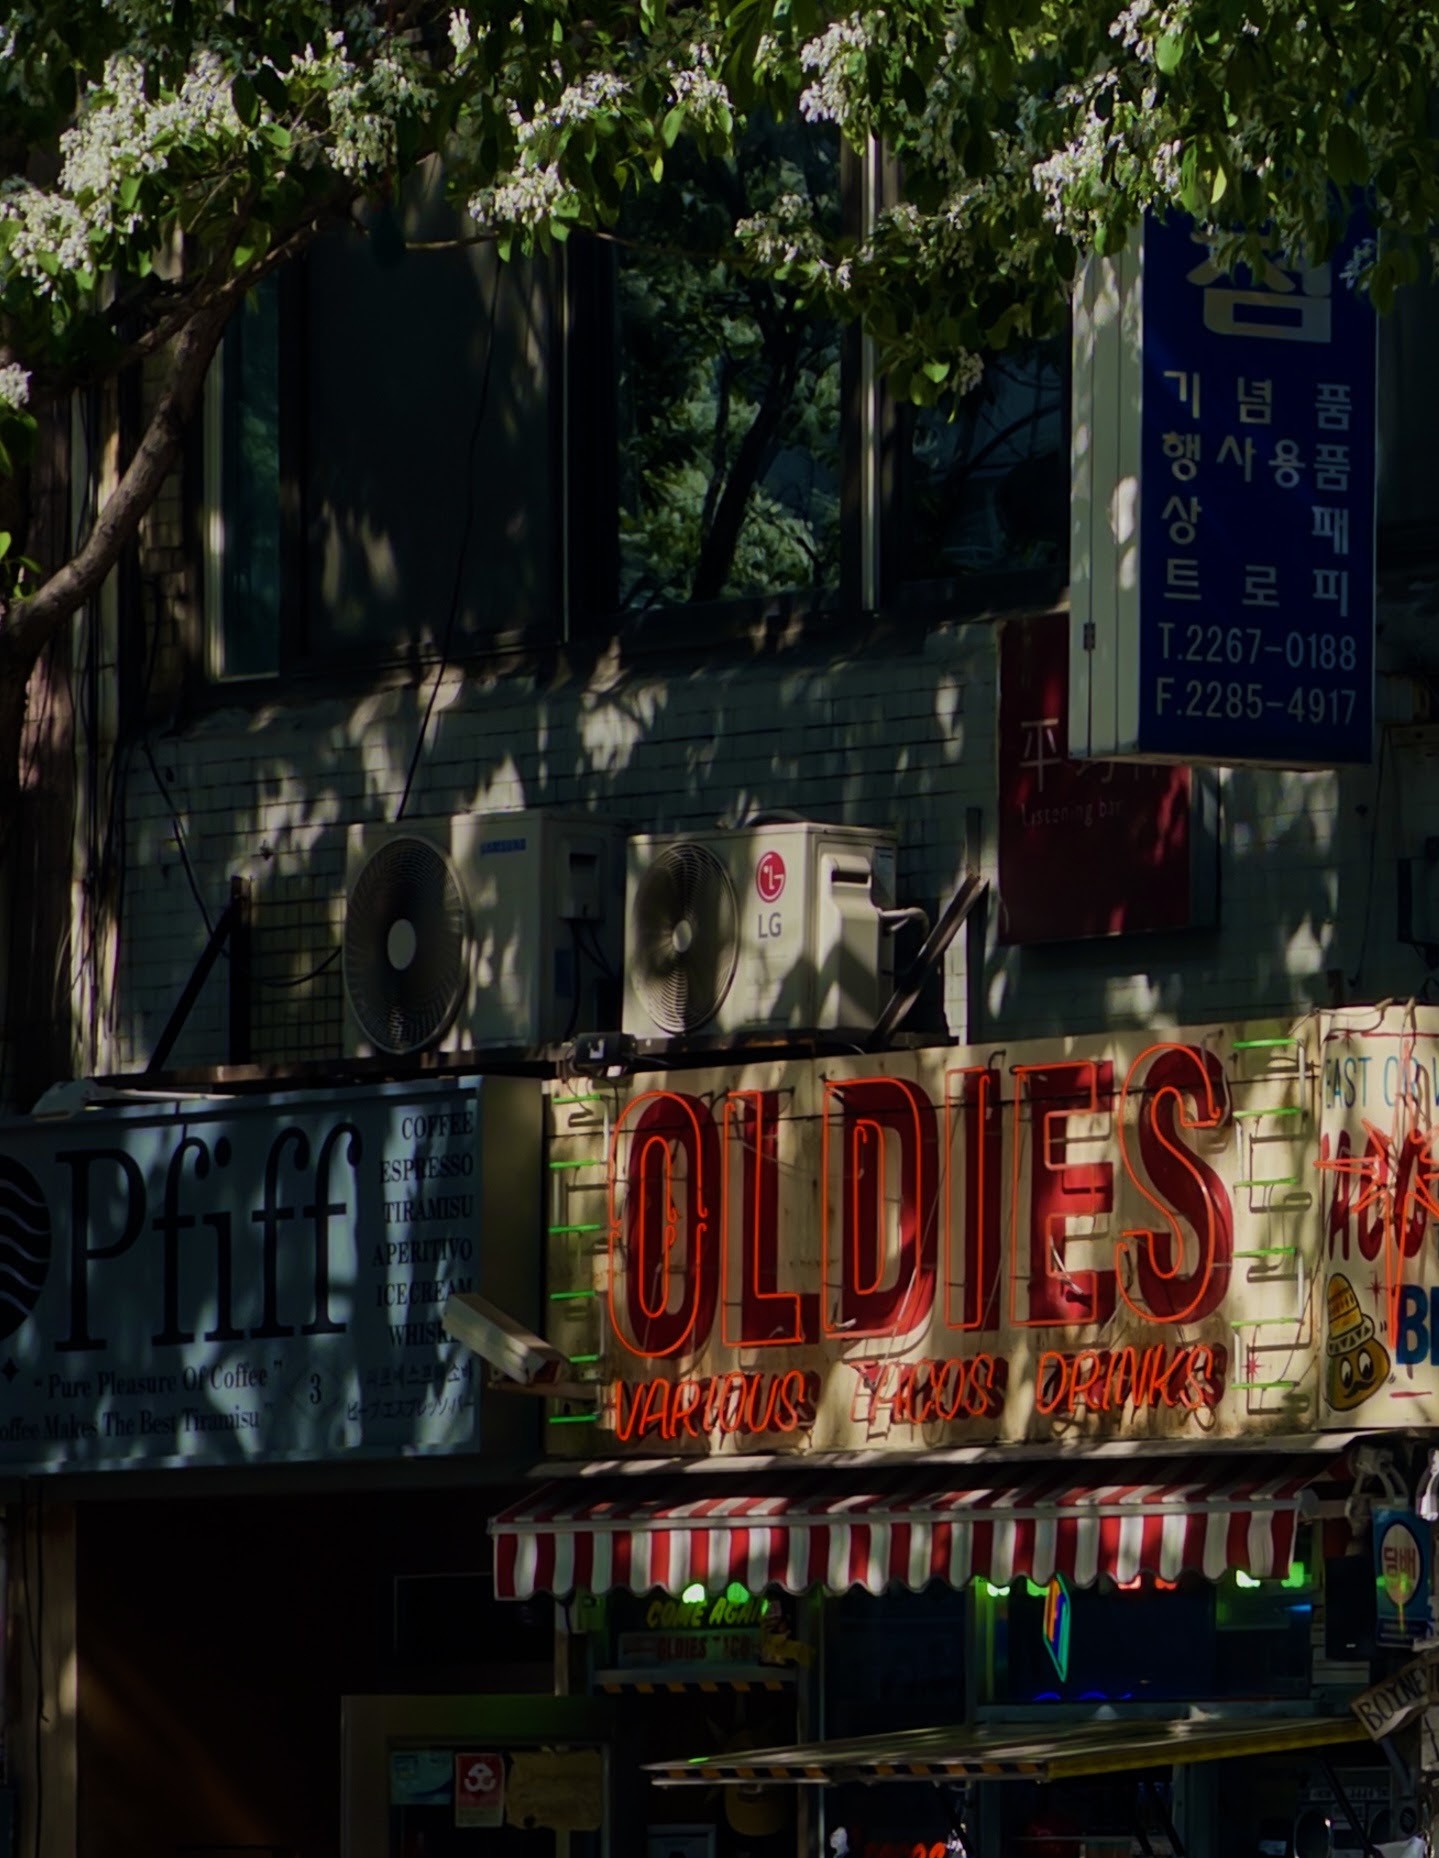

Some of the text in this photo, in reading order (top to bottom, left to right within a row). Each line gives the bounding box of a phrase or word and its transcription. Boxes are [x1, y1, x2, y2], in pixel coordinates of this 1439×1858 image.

[1163, 369, 1352, 432] 기념품
[1161, 431, 1352, 493] 행사용품
[1161, 495, 1351, 556] 상패
[1162, 557, 1350, 619] 트로피
[1157, 621, 1357, 671] T.2267-0188
[1155, 676, 1357, 726] F.2285-4917
[1020, 798, 1122, 827] Listening bar
[479, 837, 526, 857] SAMSUNG
[757, 912, 782, 939] LG
[1326, 1057, 1372, 1110] EAST
[401, 1111, 474, 1139] COFFEE
[379, 1154, 474, 1184] ESPRESSO
[383, 1196, 474, 1224] TIRAMISU
[610, 1042, 1234, 1358] OLDIES
[1321, 1129, 1431, 1262] ACO
[55, 1122, 363, 1352] Pfiff
[372, 1239, 473, 1267] APERITIVO
[376, 1277, 473, 1307] ICECREAM
[388, 1318, 461, 1347] WHISK
[49, 1363, 268, 1399] Pure Pleasure Of Coffee
[615, 1342, 1229, 1443] VARIOUS TACOS DRINKS
[0, 1404, 260, 1442] offee Makes The Best Tiramisu
[708, 1597, 765, 1626] AGAI
